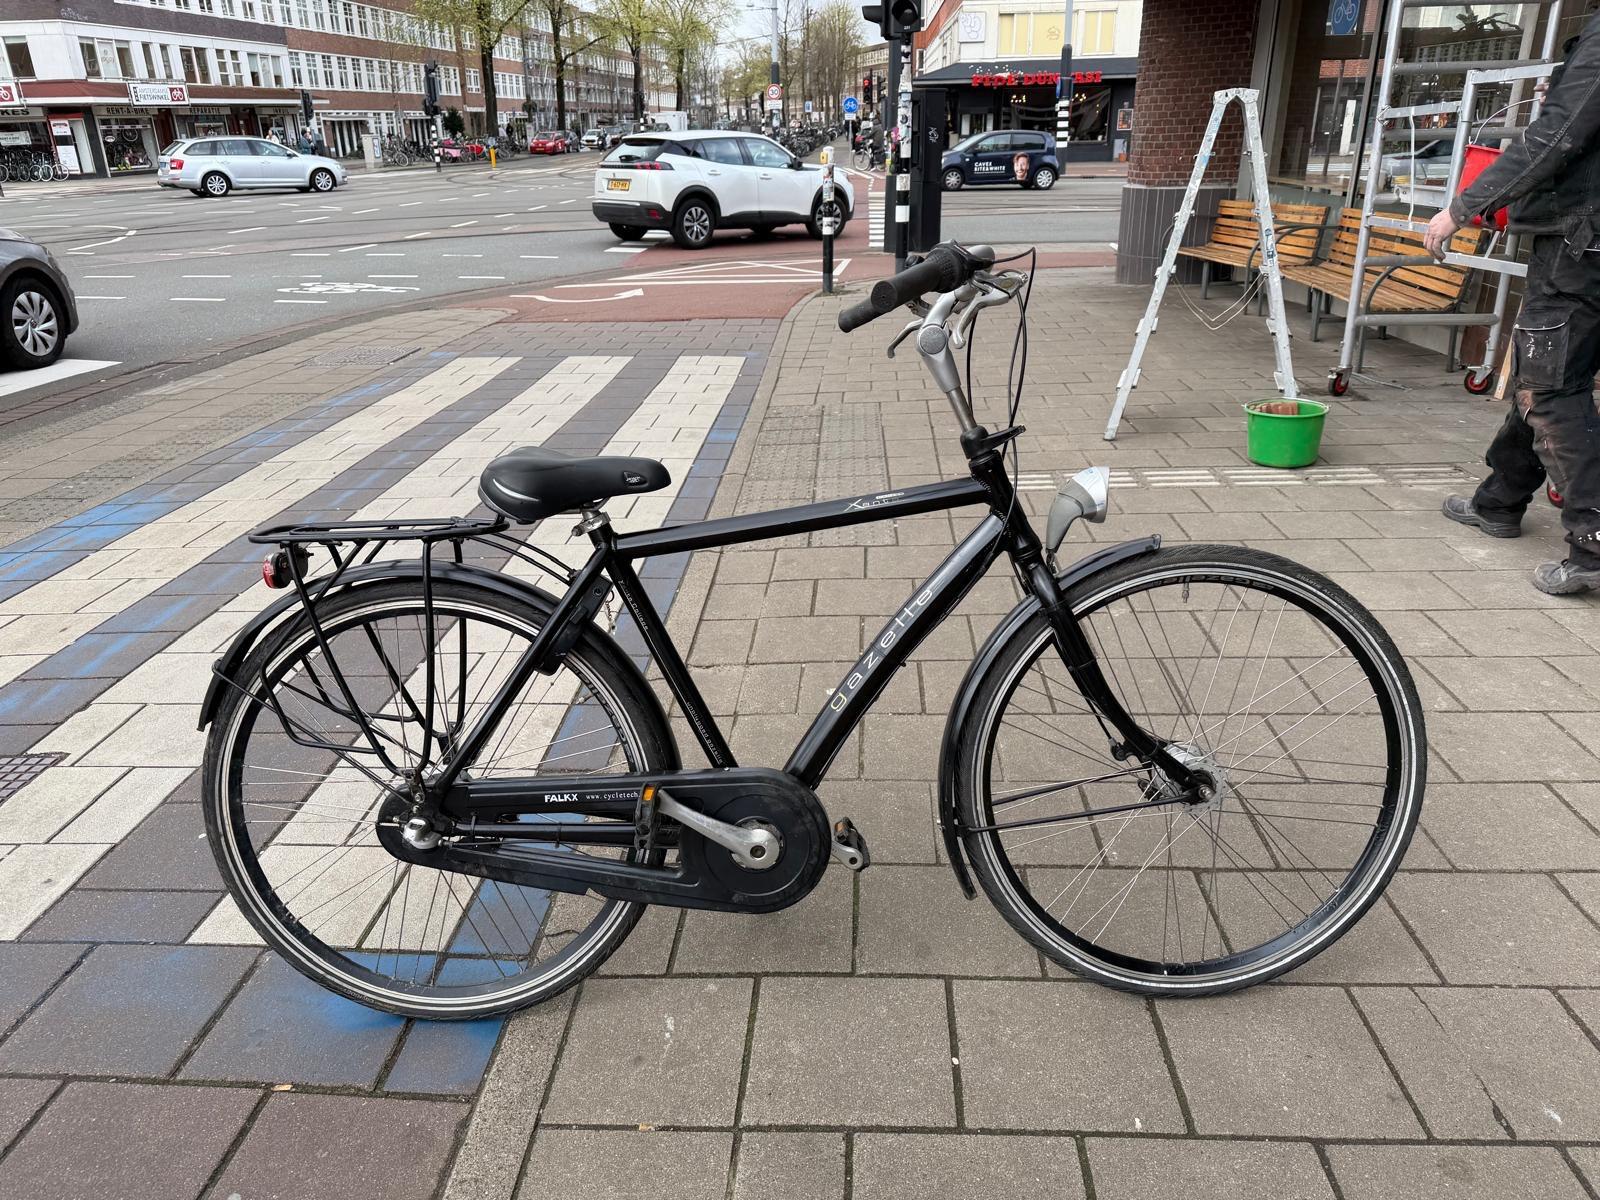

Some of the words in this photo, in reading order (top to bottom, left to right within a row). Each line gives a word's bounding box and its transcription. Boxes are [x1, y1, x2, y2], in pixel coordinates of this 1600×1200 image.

[770, 88, 779, 96] 30
[830, 589, 933, 713] gazelle
[544, 793, 579, 803] FALKX
